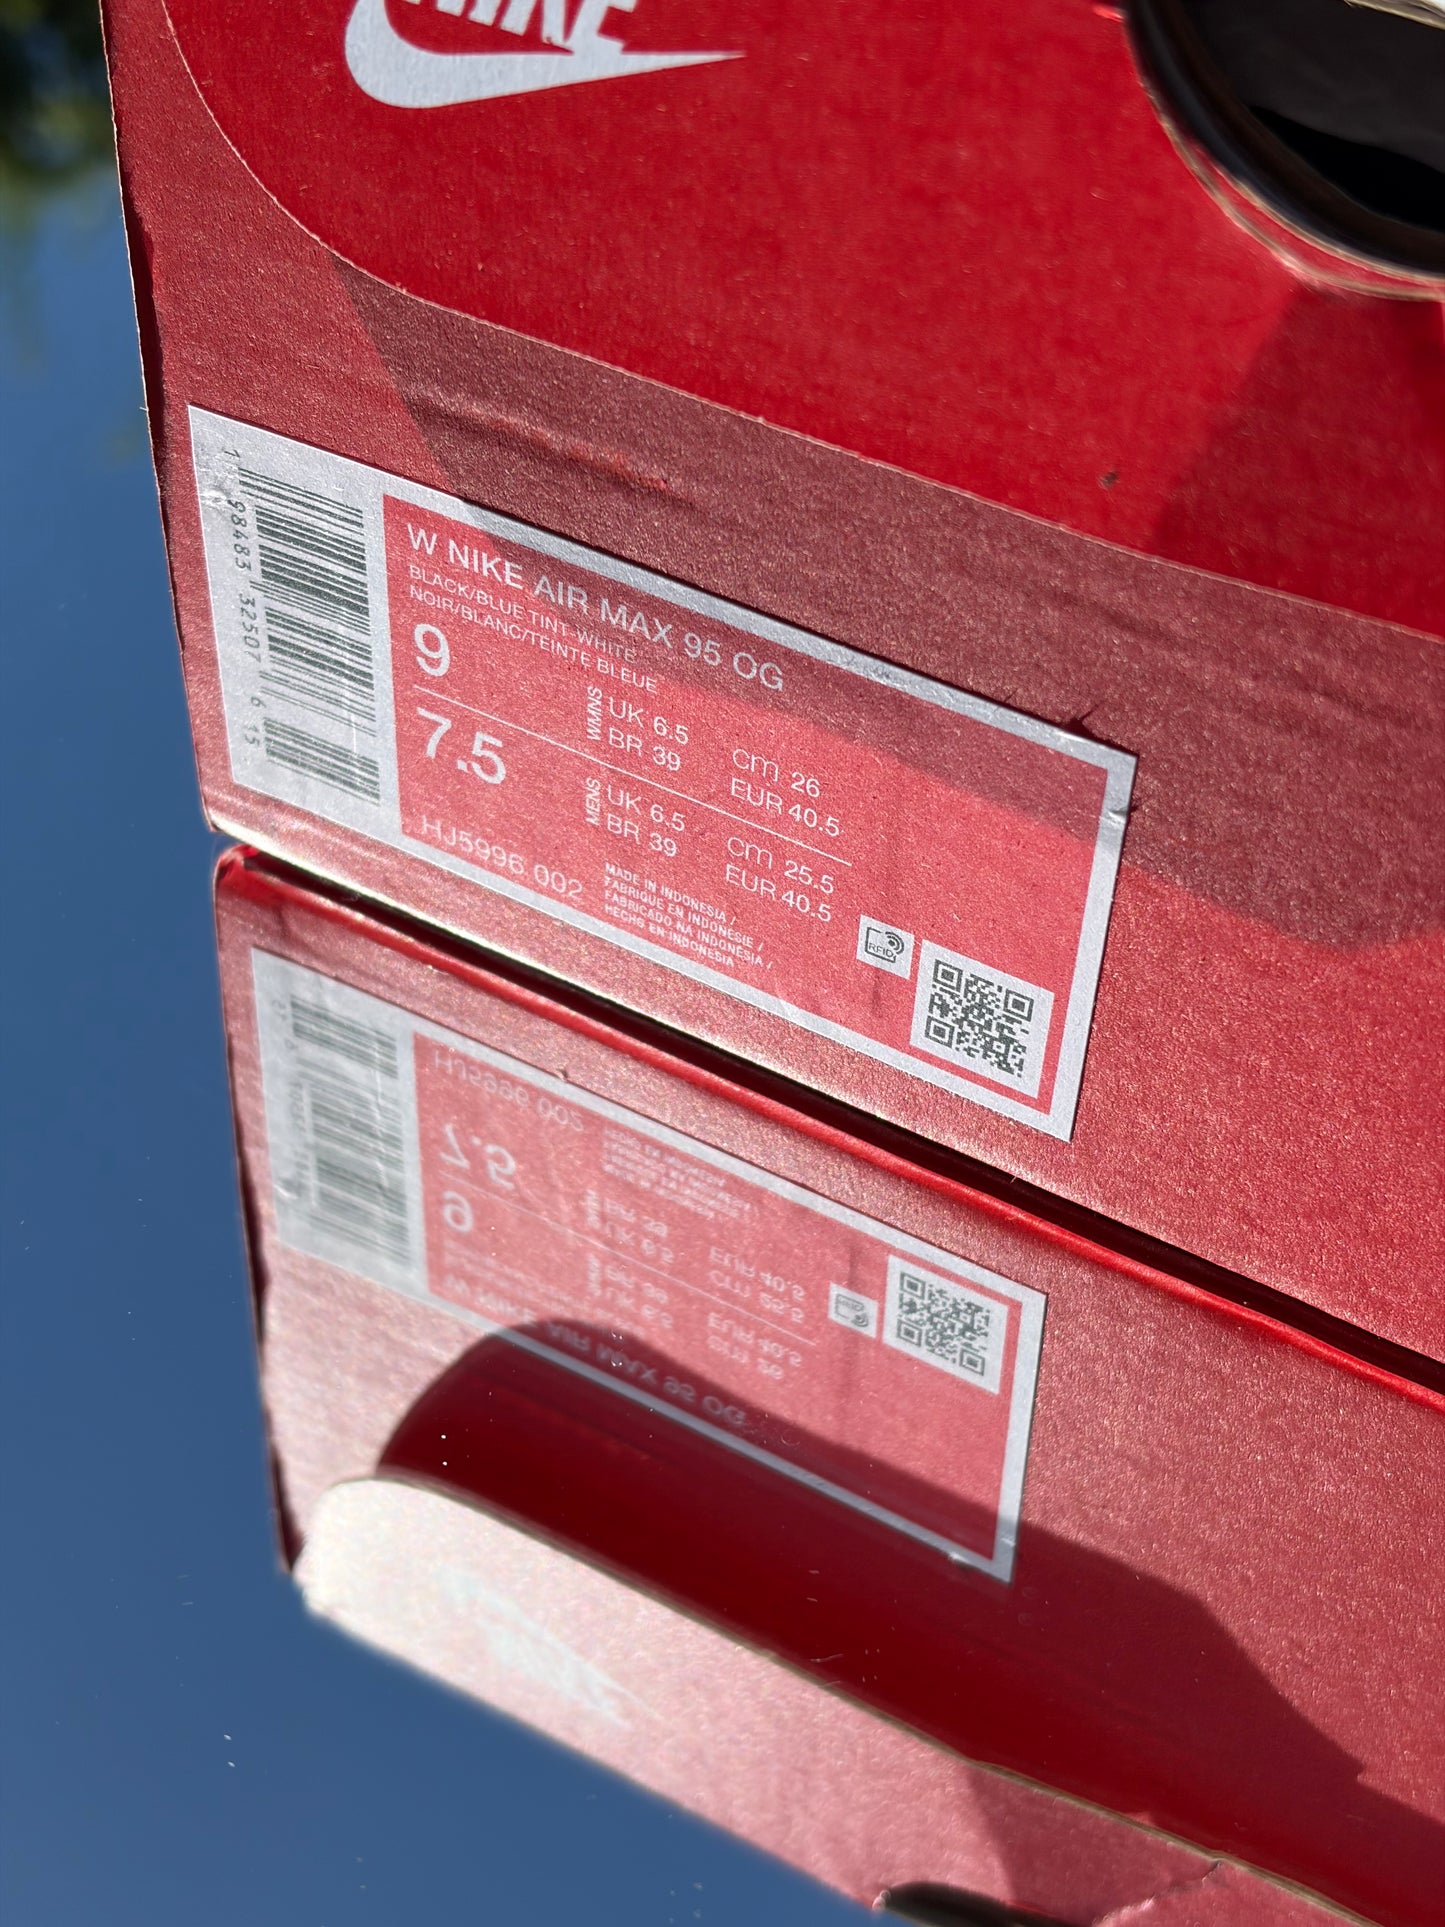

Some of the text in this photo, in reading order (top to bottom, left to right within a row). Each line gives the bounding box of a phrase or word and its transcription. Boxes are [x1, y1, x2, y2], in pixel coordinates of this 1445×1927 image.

[224, 449, 241, 459] 1
[239, 593, 262, 663] 32507
[407, 523, 784, 692] W NIKE AIR MAX 95 OG
[409, 565, 637, 664] BLACK/BLUE TINT-WHITE
[409, 586, 659, 694] NOIR/BLANC/TEINTE BLEUE
[413, 622, 451, 678] 9
[250, 696, 267, 709] 6
[586, 686, 603, 741] WMNS
[608, 696, 689, 745] UK 6.5
[416, 706, 507, 784] 7.5
[608, 727, 681, 772] BR 39
[585, 776, 601, 826] MENS
[607, 784, 686, 833] UK 6.5
[730, 778, 840, 837] EUR 40.5
[790, 771, 821, 798] 26
[420, 814, 584, 899] HJ5996 002
[607, 813, 678, 857] BR 39
[604, 876, 664, 910] FABRIQUE
[667, 902, 685, 919] EN
[605, 863, 640, 885] MADE
[645, 878, 657, 892] IN
[661, 885, 727, 924] INDONESIA
[726, 864, 832, 922] EUR 40.5
[784, 860, 835, 895] 25.5
[604, 890, 672, 926] FABRICADO
[676, 920, 694, 937] NA
[649, 922, 665, 937] EN
[669, 929, 735, 967] INDONESIA
[868, 942, 894, 958] RFID
